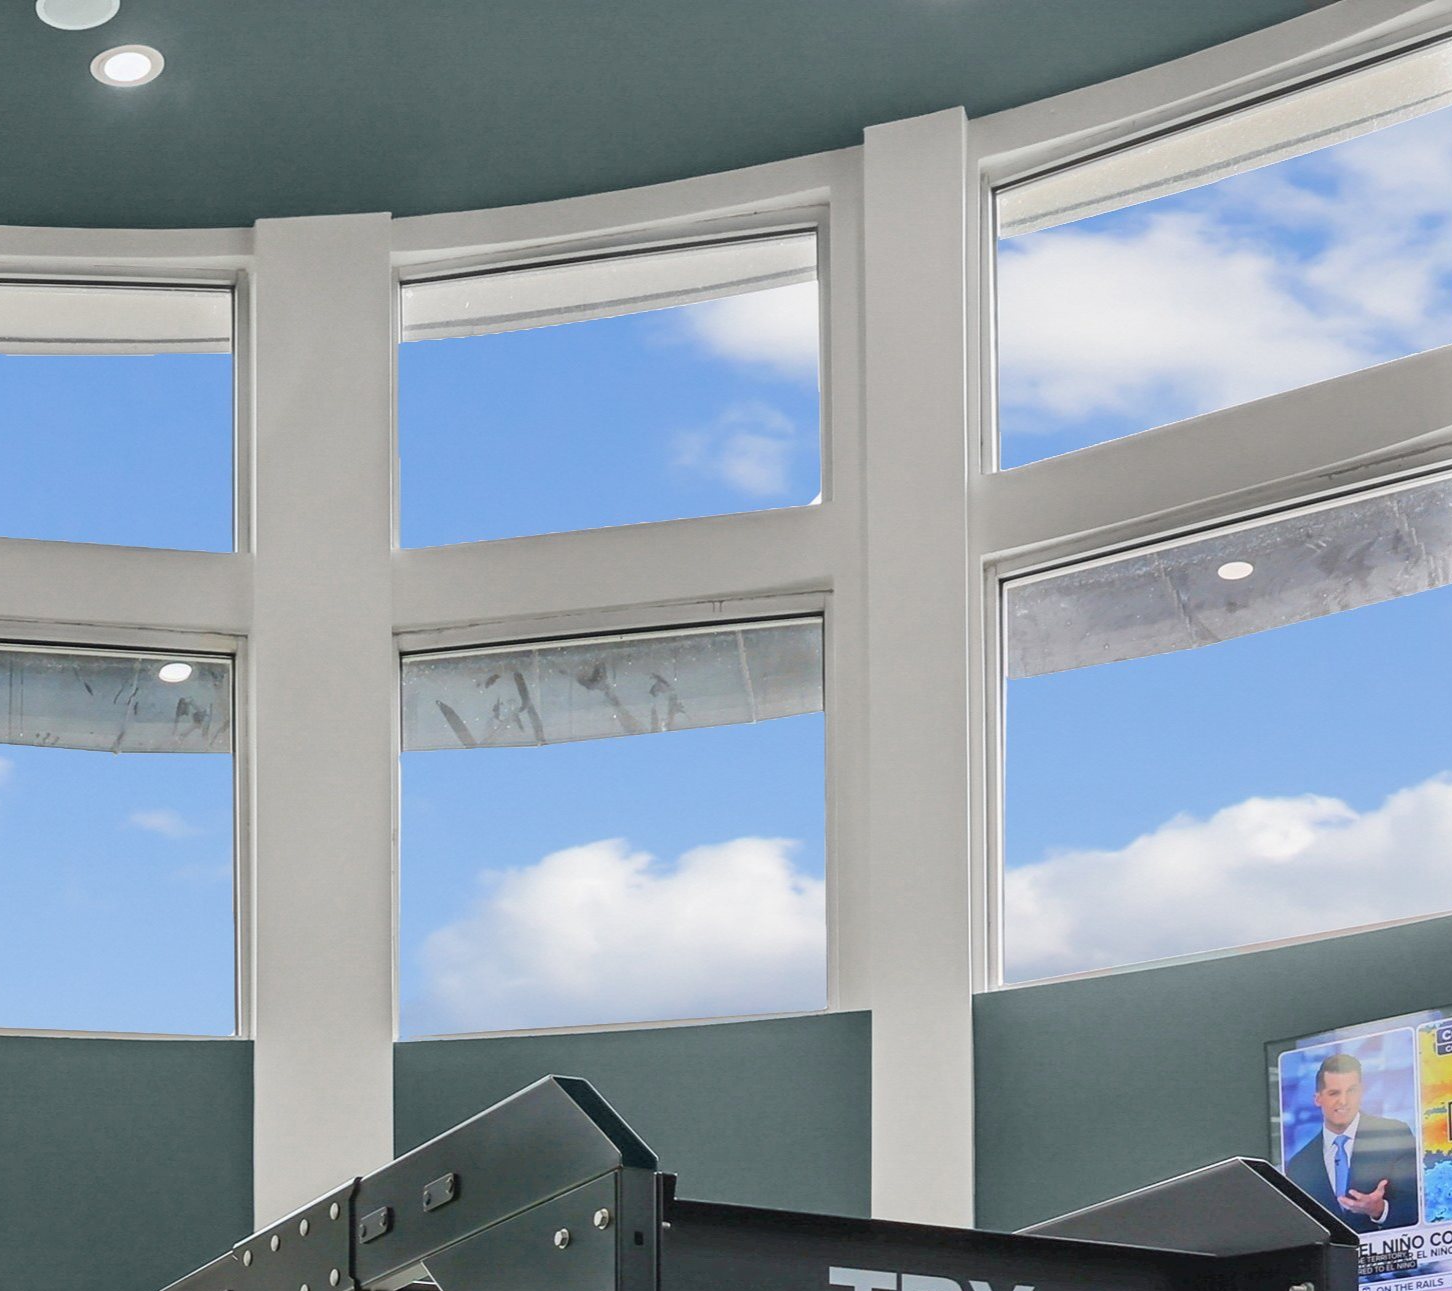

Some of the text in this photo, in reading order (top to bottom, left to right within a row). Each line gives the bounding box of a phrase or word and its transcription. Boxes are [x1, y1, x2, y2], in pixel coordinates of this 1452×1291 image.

[1358, 1243, 1377, 1258] EL
[1382, 1233, 1425, 1256] NIÑO
[1416, 1250, 1428, 1260] EL
[1395, 1281, 1414, 1291] THE
[1416, 1278, 1444, 1290] RAILS
